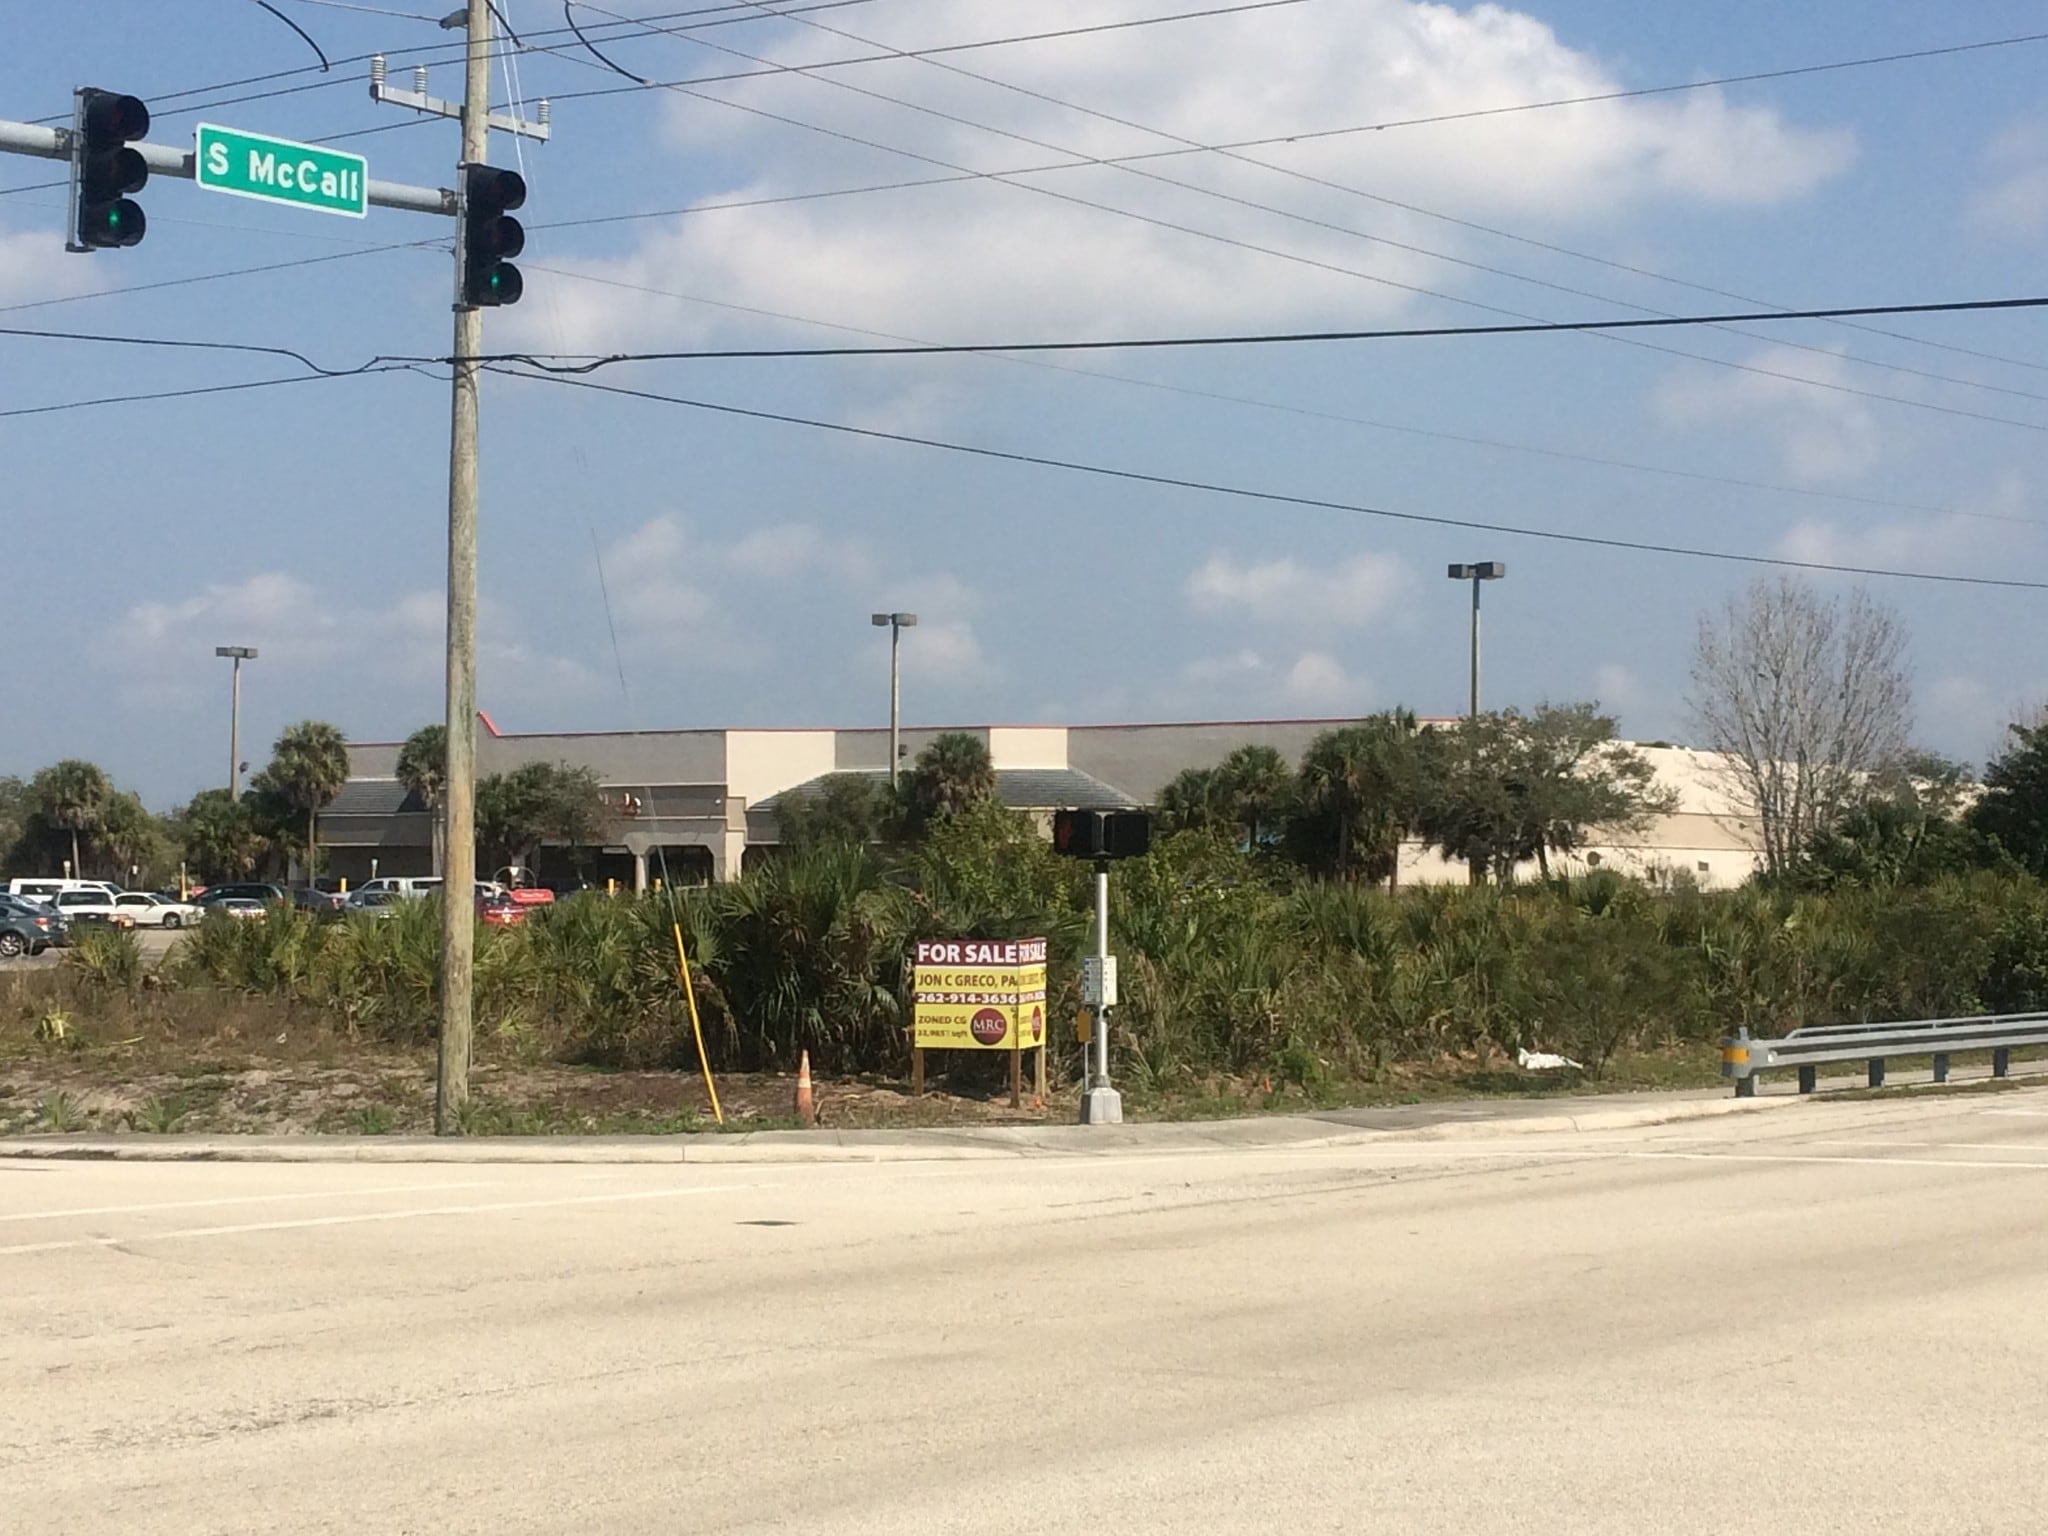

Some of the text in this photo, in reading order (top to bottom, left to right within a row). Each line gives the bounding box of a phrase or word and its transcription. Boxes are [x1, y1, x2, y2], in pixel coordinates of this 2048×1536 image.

[207, 142, 358, 201] S McCall
[918, 944, 1017, 963] FOR SALE
[918, 974, 941, 987] JON
[946, 975, 951, 986] C
[955, 974, 998, 989] GRECO,
[918, 1015, 952, 1025] ZONED
[973, 1018, 1004, 1031] MRC
